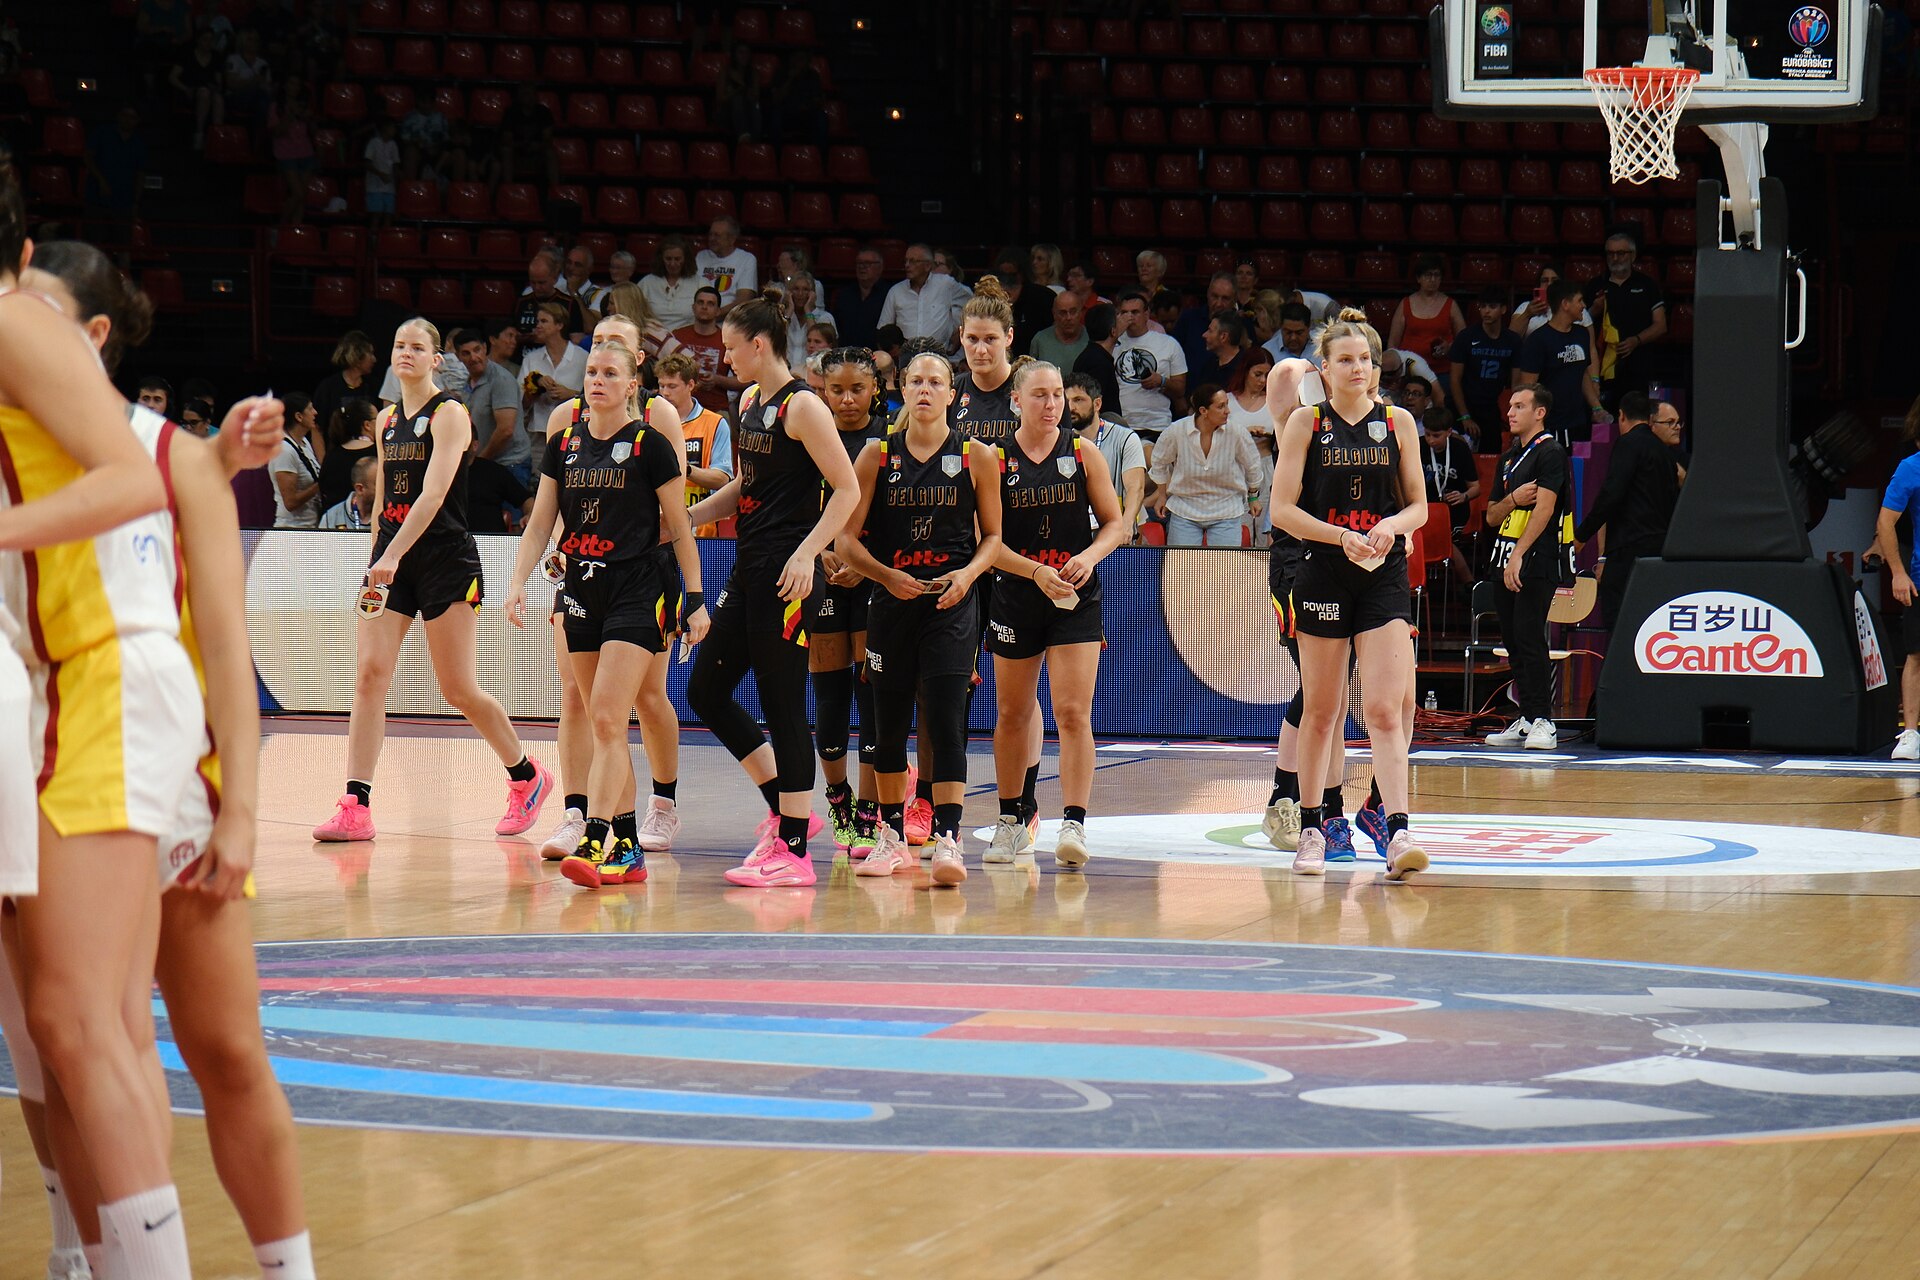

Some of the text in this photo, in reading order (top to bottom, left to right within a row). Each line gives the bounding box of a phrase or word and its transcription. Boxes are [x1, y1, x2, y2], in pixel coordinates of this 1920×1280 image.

[1484, 44, 1508, 57] FIBA
[1782, 58, 1833, 68] EUROBASKET
[1557, 351, 1577, 359] NORTH
[1480, 359, 1500, 379] 12
[384, 441, 425, 461] BELGIUM
[1321, 446, 1390, 466] BELGIUM
[565, 467, 626, 489] BELGIUM
[1350, 475, 1362, 500] 5
[887, 485, 957, 506] BELGIUM
[1009, 482, 1076, 509] BELGIUM
[1039, 515, 1050, 539] 4
[1327, 508, 1382, 531] lotto
[893, 549, 950, 569] lotto
[569, 606, 587, 619] ADE
[1303, 601, 1340, 613] POWER
[1318, 611, 1340, 621] ADE
[1668, 604, 1772, 633] 百岁山
[997, 632, 1017, 644] ADE
